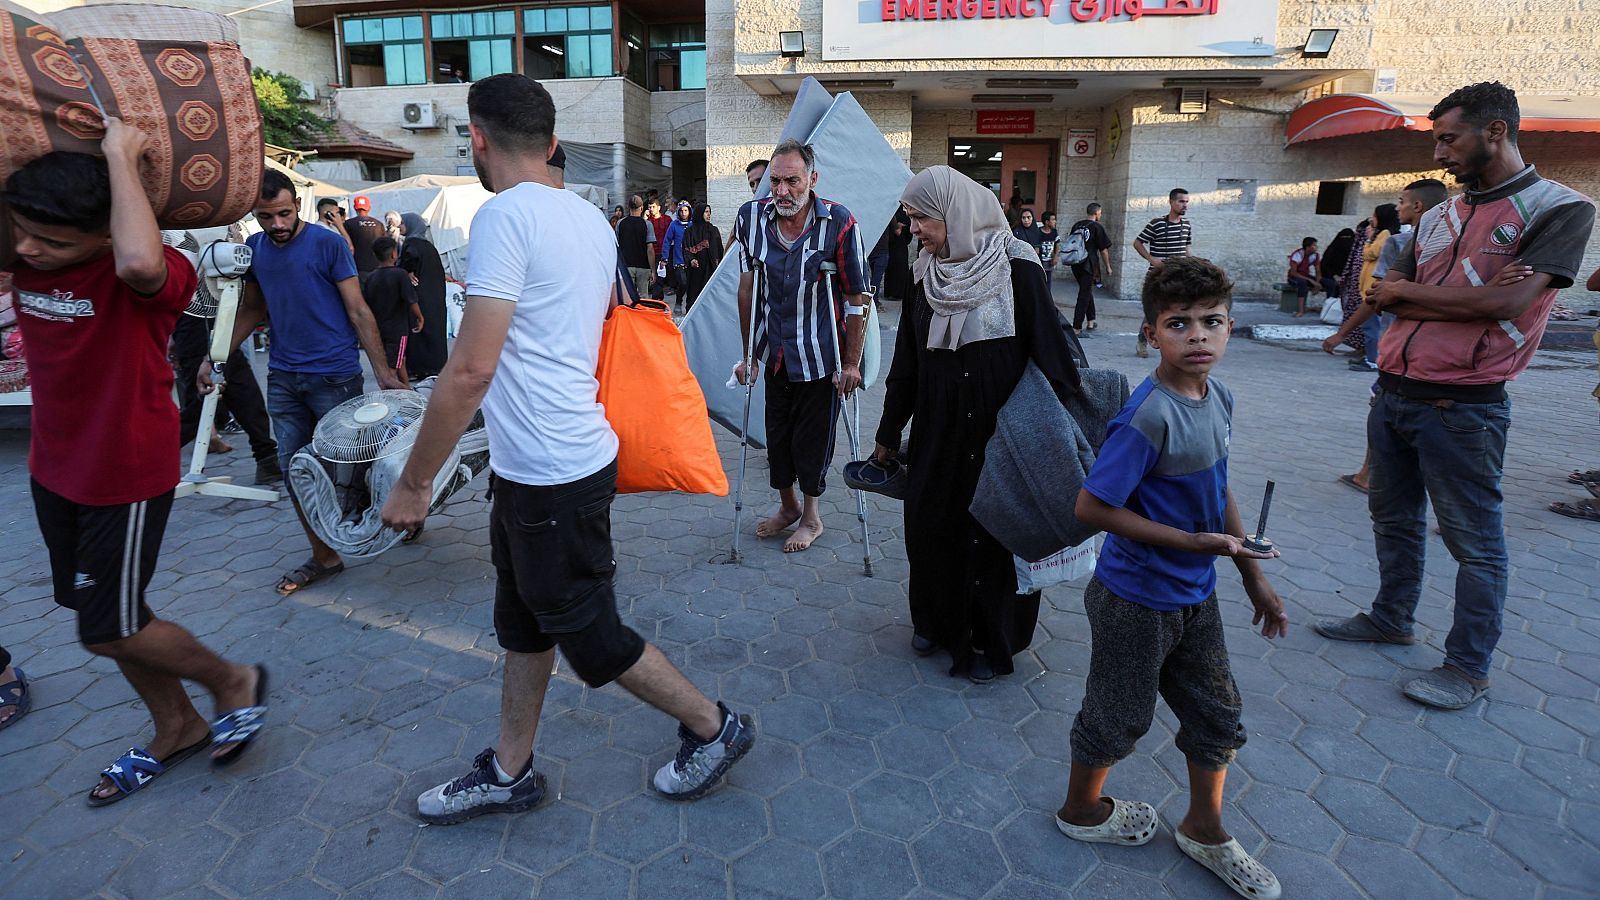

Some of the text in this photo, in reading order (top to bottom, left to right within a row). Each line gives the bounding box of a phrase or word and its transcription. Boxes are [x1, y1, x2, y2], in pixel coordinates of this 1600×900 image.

[881, 0, 1051, 21] EMERGENCY
[1028, 564, 1044, 572] YOU
[1045, 560, 1060, 569] ARE
